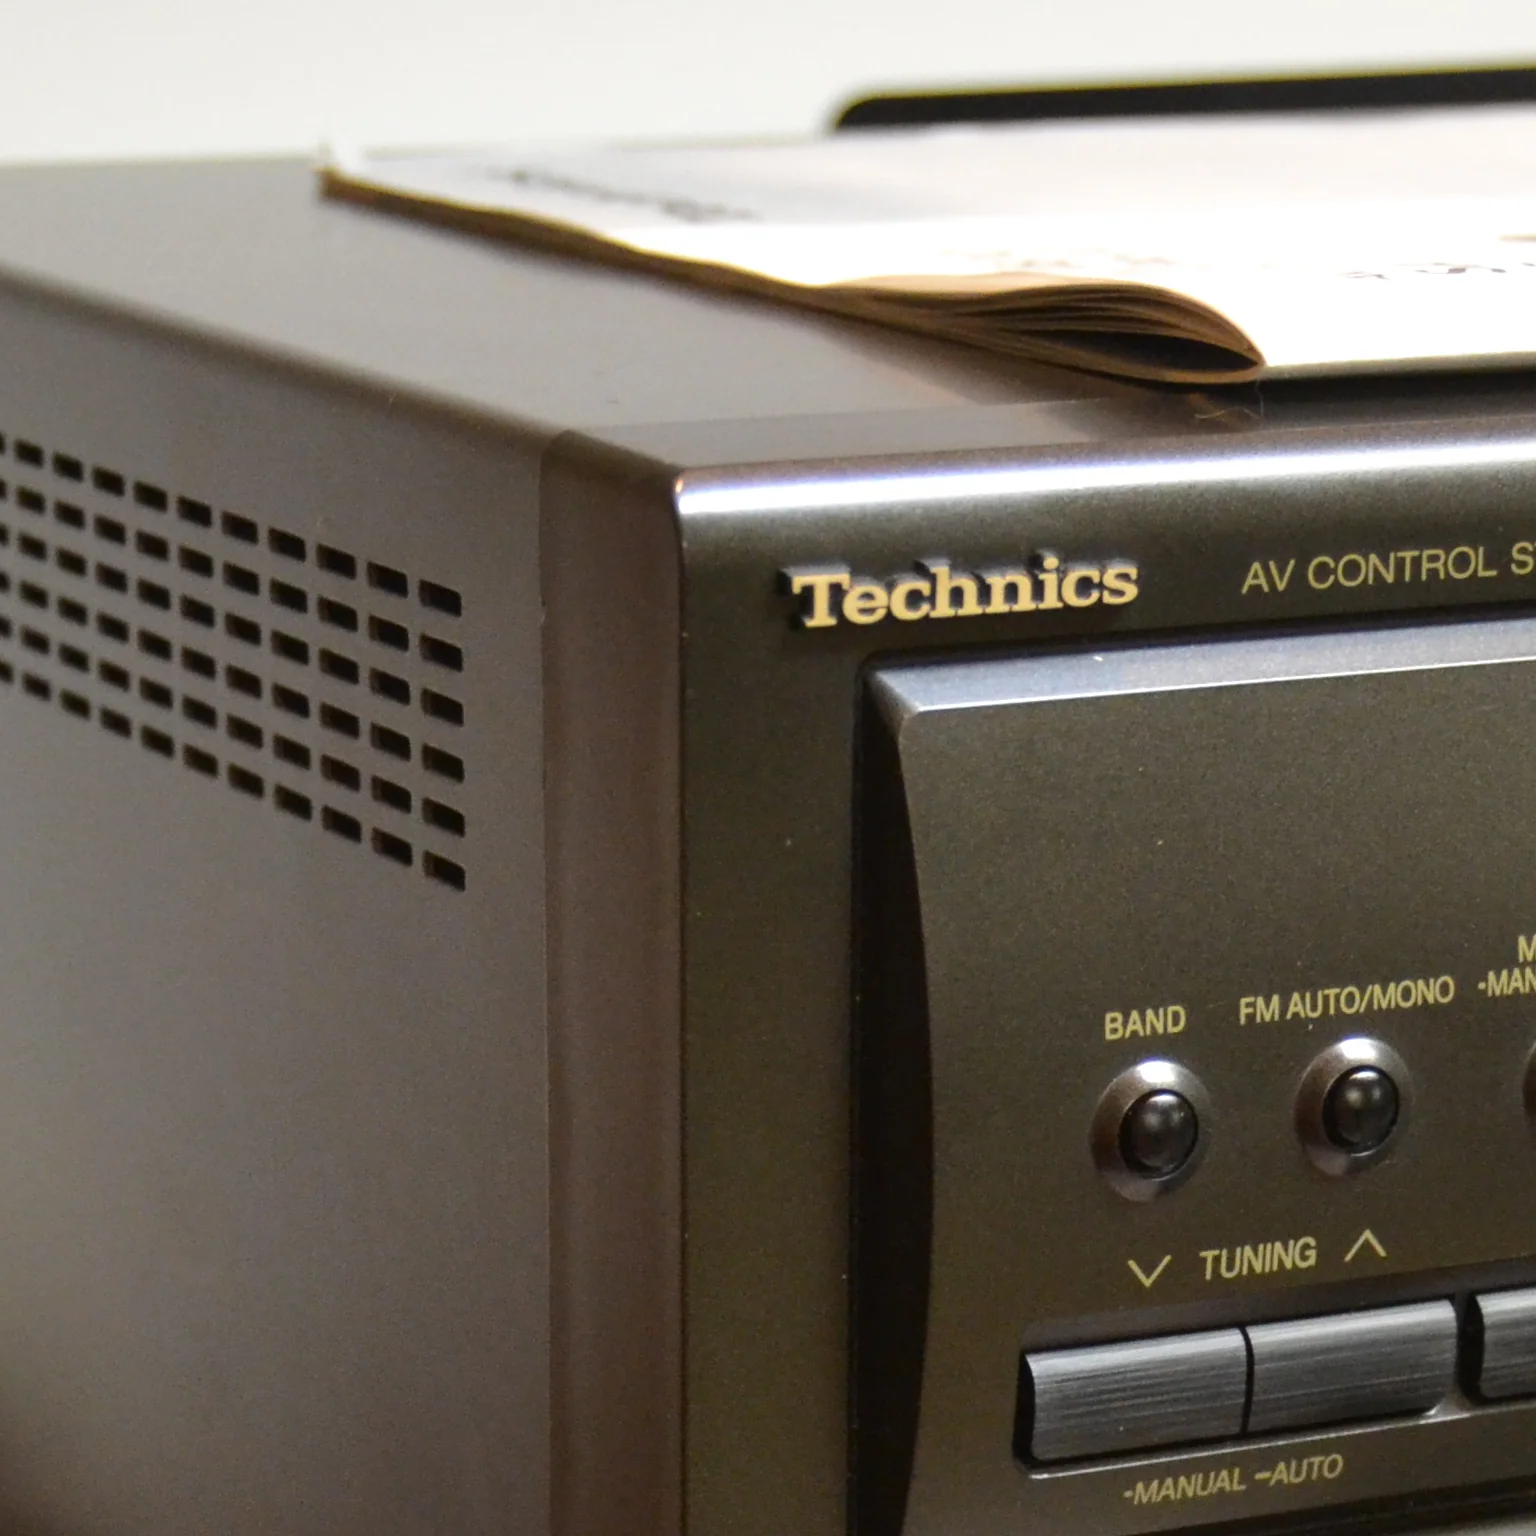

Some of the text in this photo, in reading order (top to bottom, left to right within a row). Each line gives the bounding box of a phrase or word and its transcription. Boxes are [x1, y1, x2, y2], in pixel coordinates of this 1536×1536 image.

[790, 556, 1140, 629] Technics
[1241, 559, 1296, 595] AV
[1307, 545, 1497, 589] CONTROL
[1102, 1004, 1188, 1041] BAND
[1238, 974, 1457, 1027] FM AUTO/MONO
[1199, 1236, 1318, 1282] TUNING
